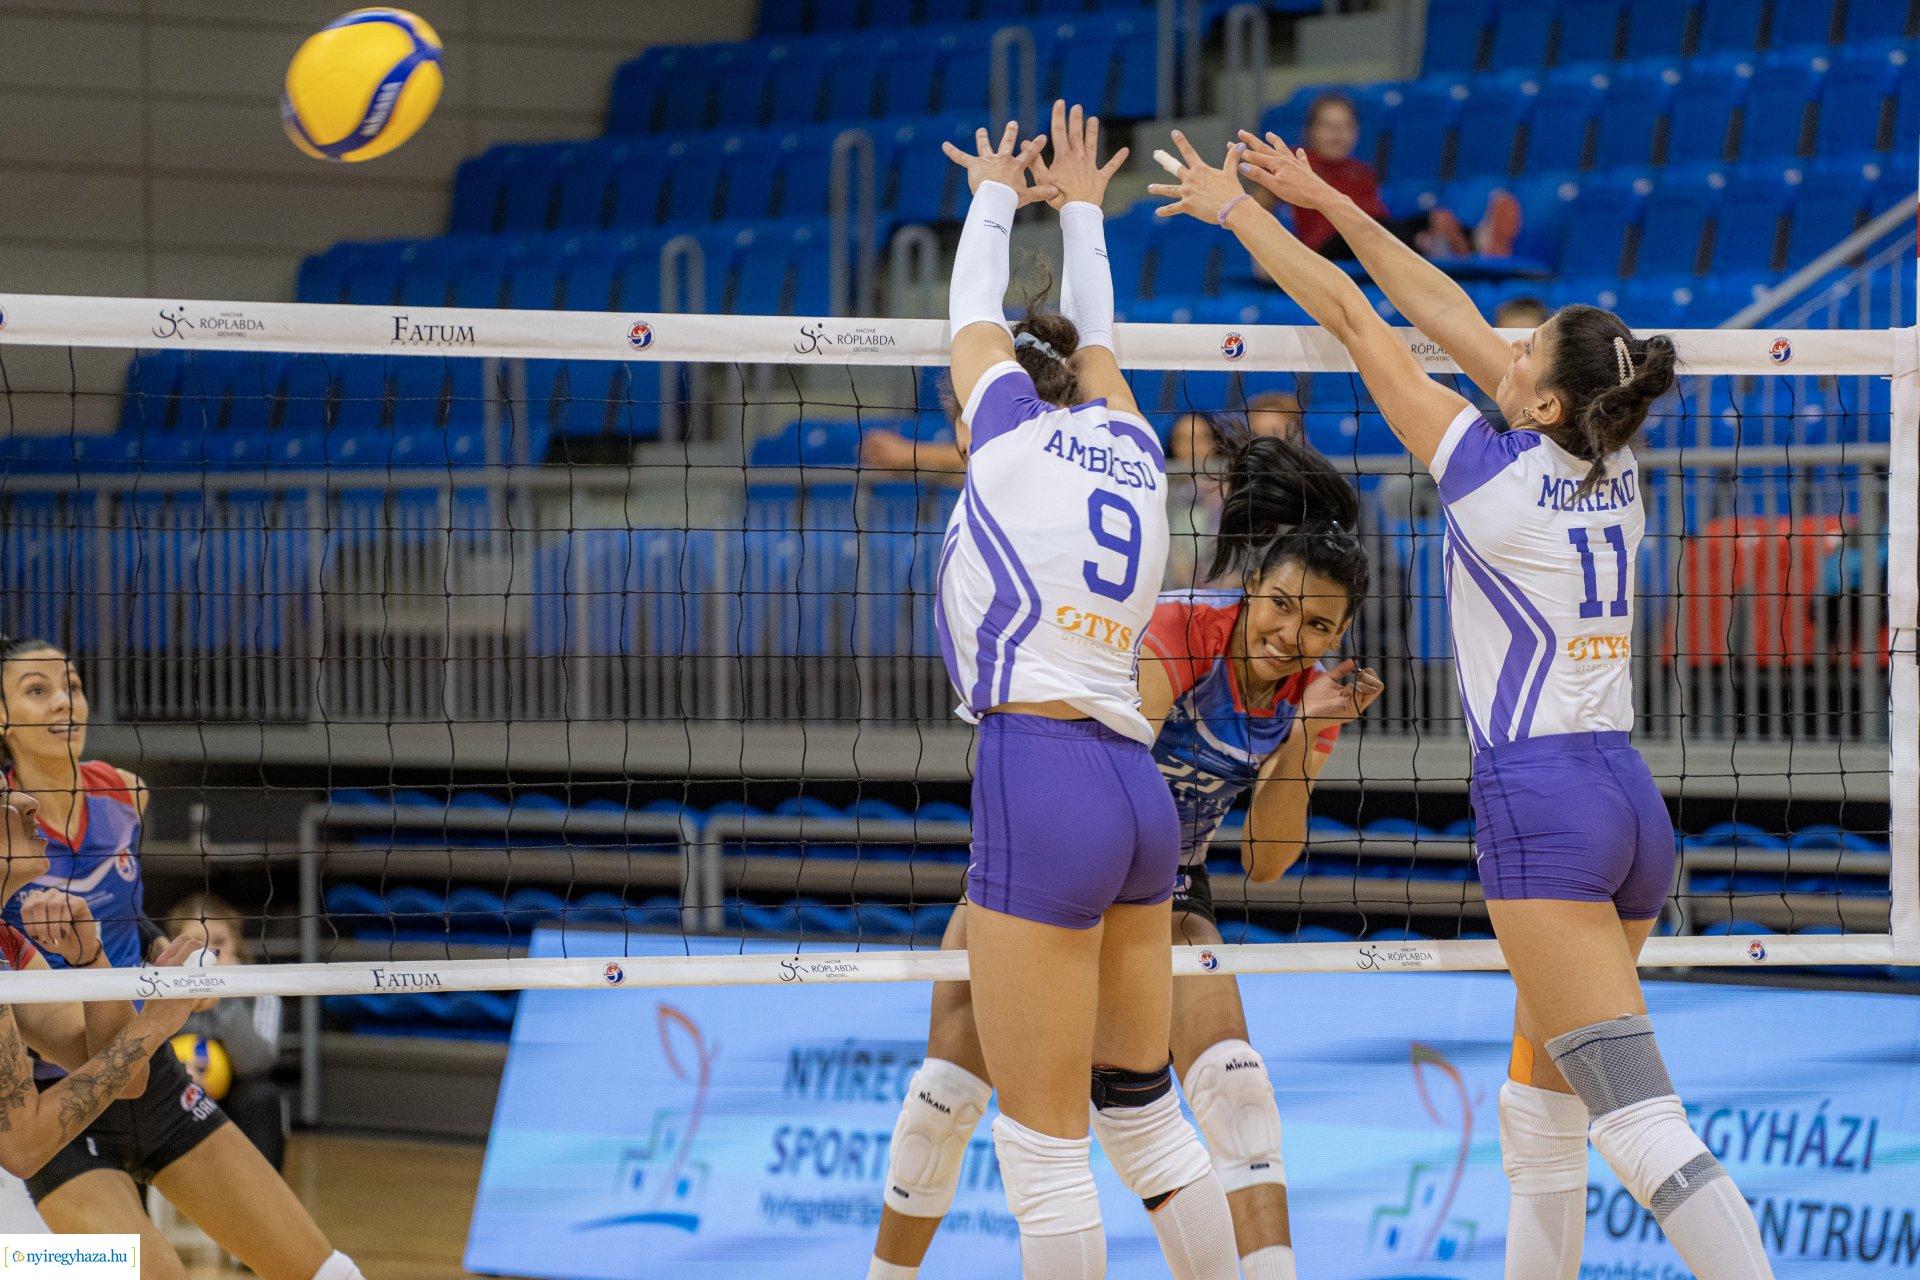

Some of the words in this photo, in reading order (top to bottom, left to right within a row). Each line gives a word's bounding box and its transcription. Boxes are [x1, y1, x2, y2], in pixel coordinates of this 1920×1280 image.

[200, 316, 265, 330] RÖPLABDA
[837, 332, 896, 345] RÖPLABDA
[1537, 469, 1634, 512] MORENO
[1083, 488, 1141, 603] 9
[1568, 524, 1628, 618] 11
[1388, 951, 1433, 960] RÖPLABDA
